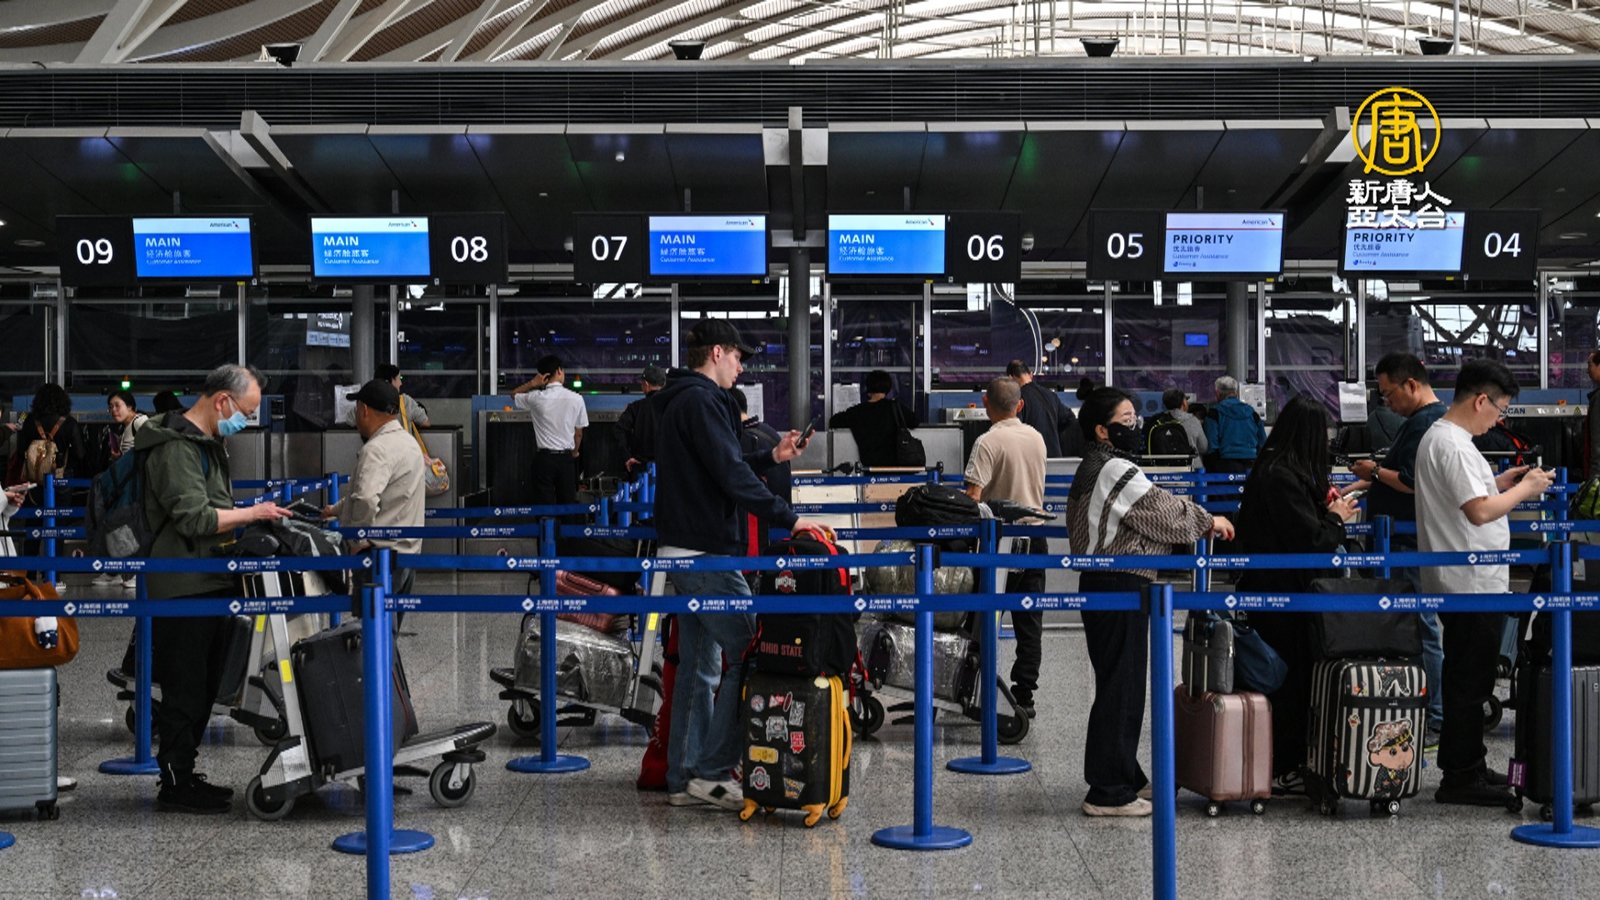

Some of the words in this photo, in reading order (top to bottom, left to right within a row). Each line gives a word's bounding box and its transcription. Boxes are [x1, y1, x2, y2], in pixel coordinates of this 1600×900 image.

[145, 238, 180, 247] MAIN
[324, 236, 359, 246] MAIN
[660, 235, 695, 244] MAIN
[839, 234, 875, 244] MAIN
[1107, 233, 1143, 258] 05
[1173, 235, 1233, 244] PRIORITY
[1354, 233, 1414, 242] PRIORITY
[1484, 232, 1521, 258] 04
[77, 239, 113, 264] 09
[451, 236, 488, 262] 08
[591, 236, 628, 260] 07
[967, 235, 1004, 260] 06
[760, 641, 779, 654] OHIO
[781, 644, 803, 657] STATE
